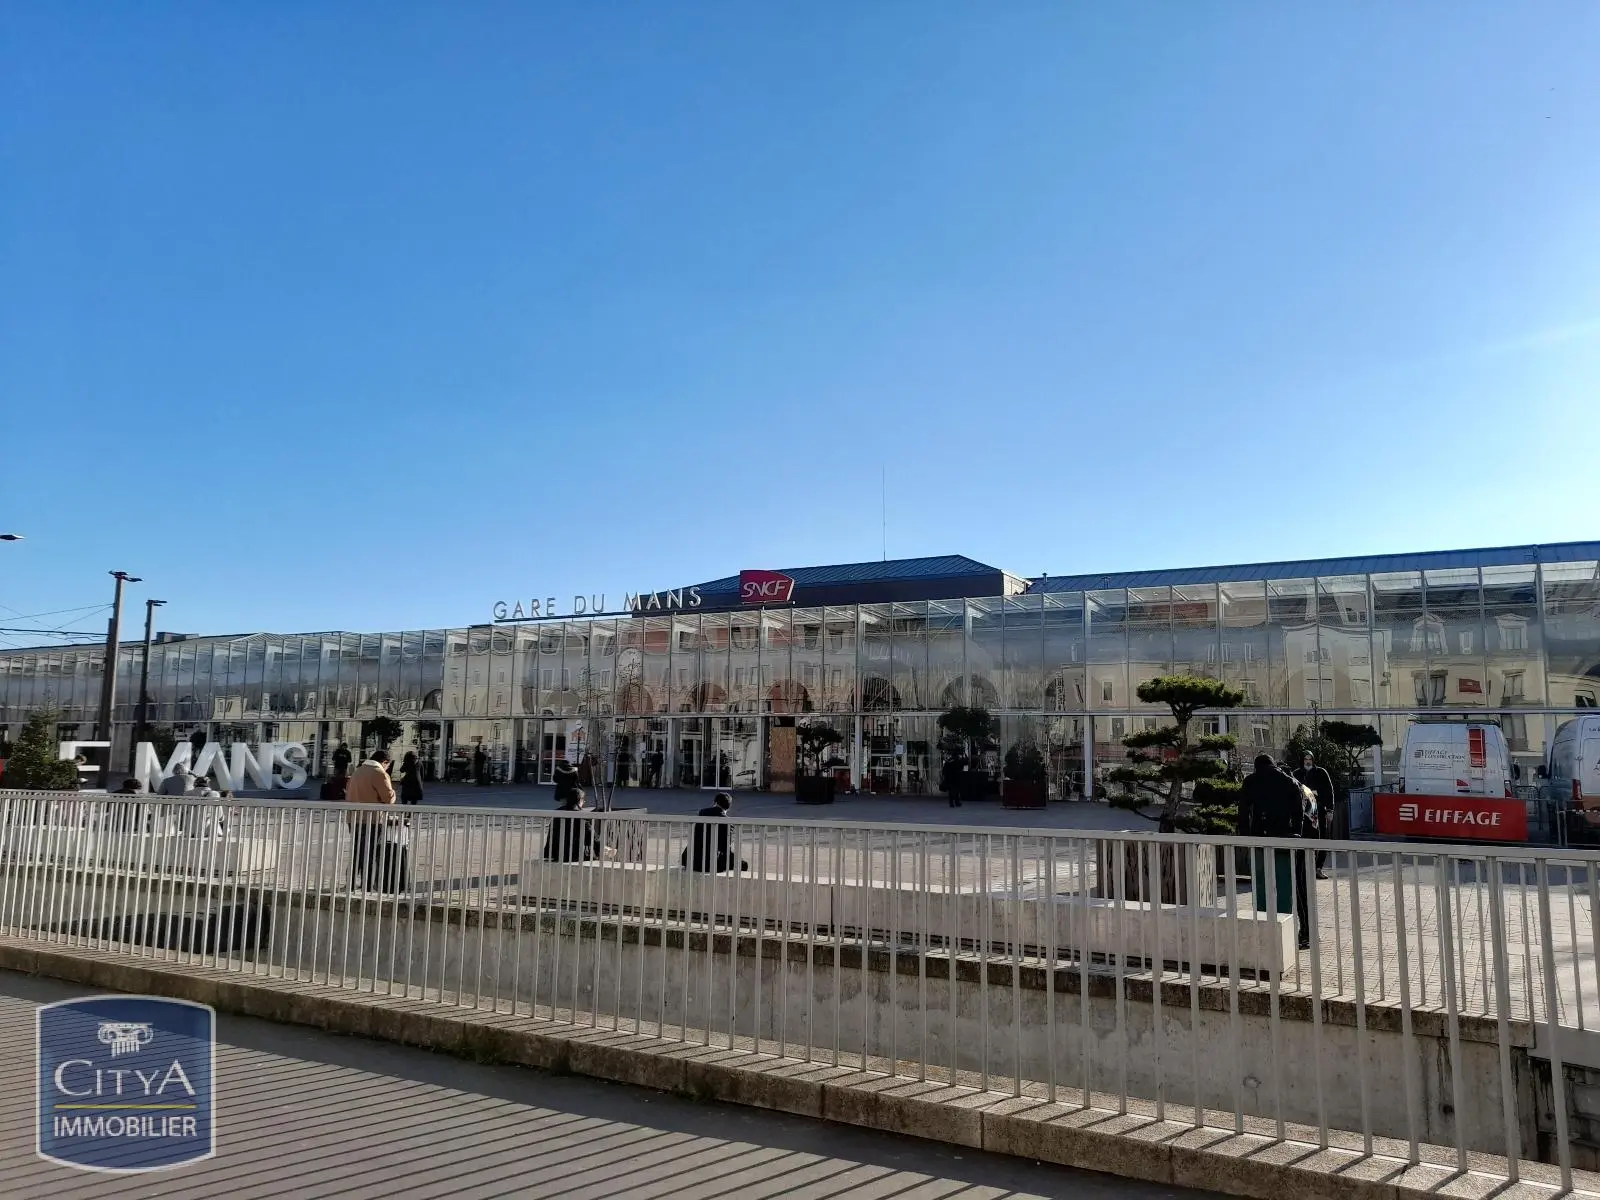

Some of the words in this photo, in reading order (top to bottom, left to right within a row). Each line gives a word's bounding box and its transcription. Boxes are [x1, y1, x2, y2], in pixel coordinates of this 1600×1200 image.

[740, 579, 789, 598] SNCF
[493, 597, 556, 620] GARE
[574, 593, 605, 615] DU
[623, 586, 702, 611] MANS
[135, 741, 308, 794] MANS
[1424, 809, 1503, 826] EIFFAGE
